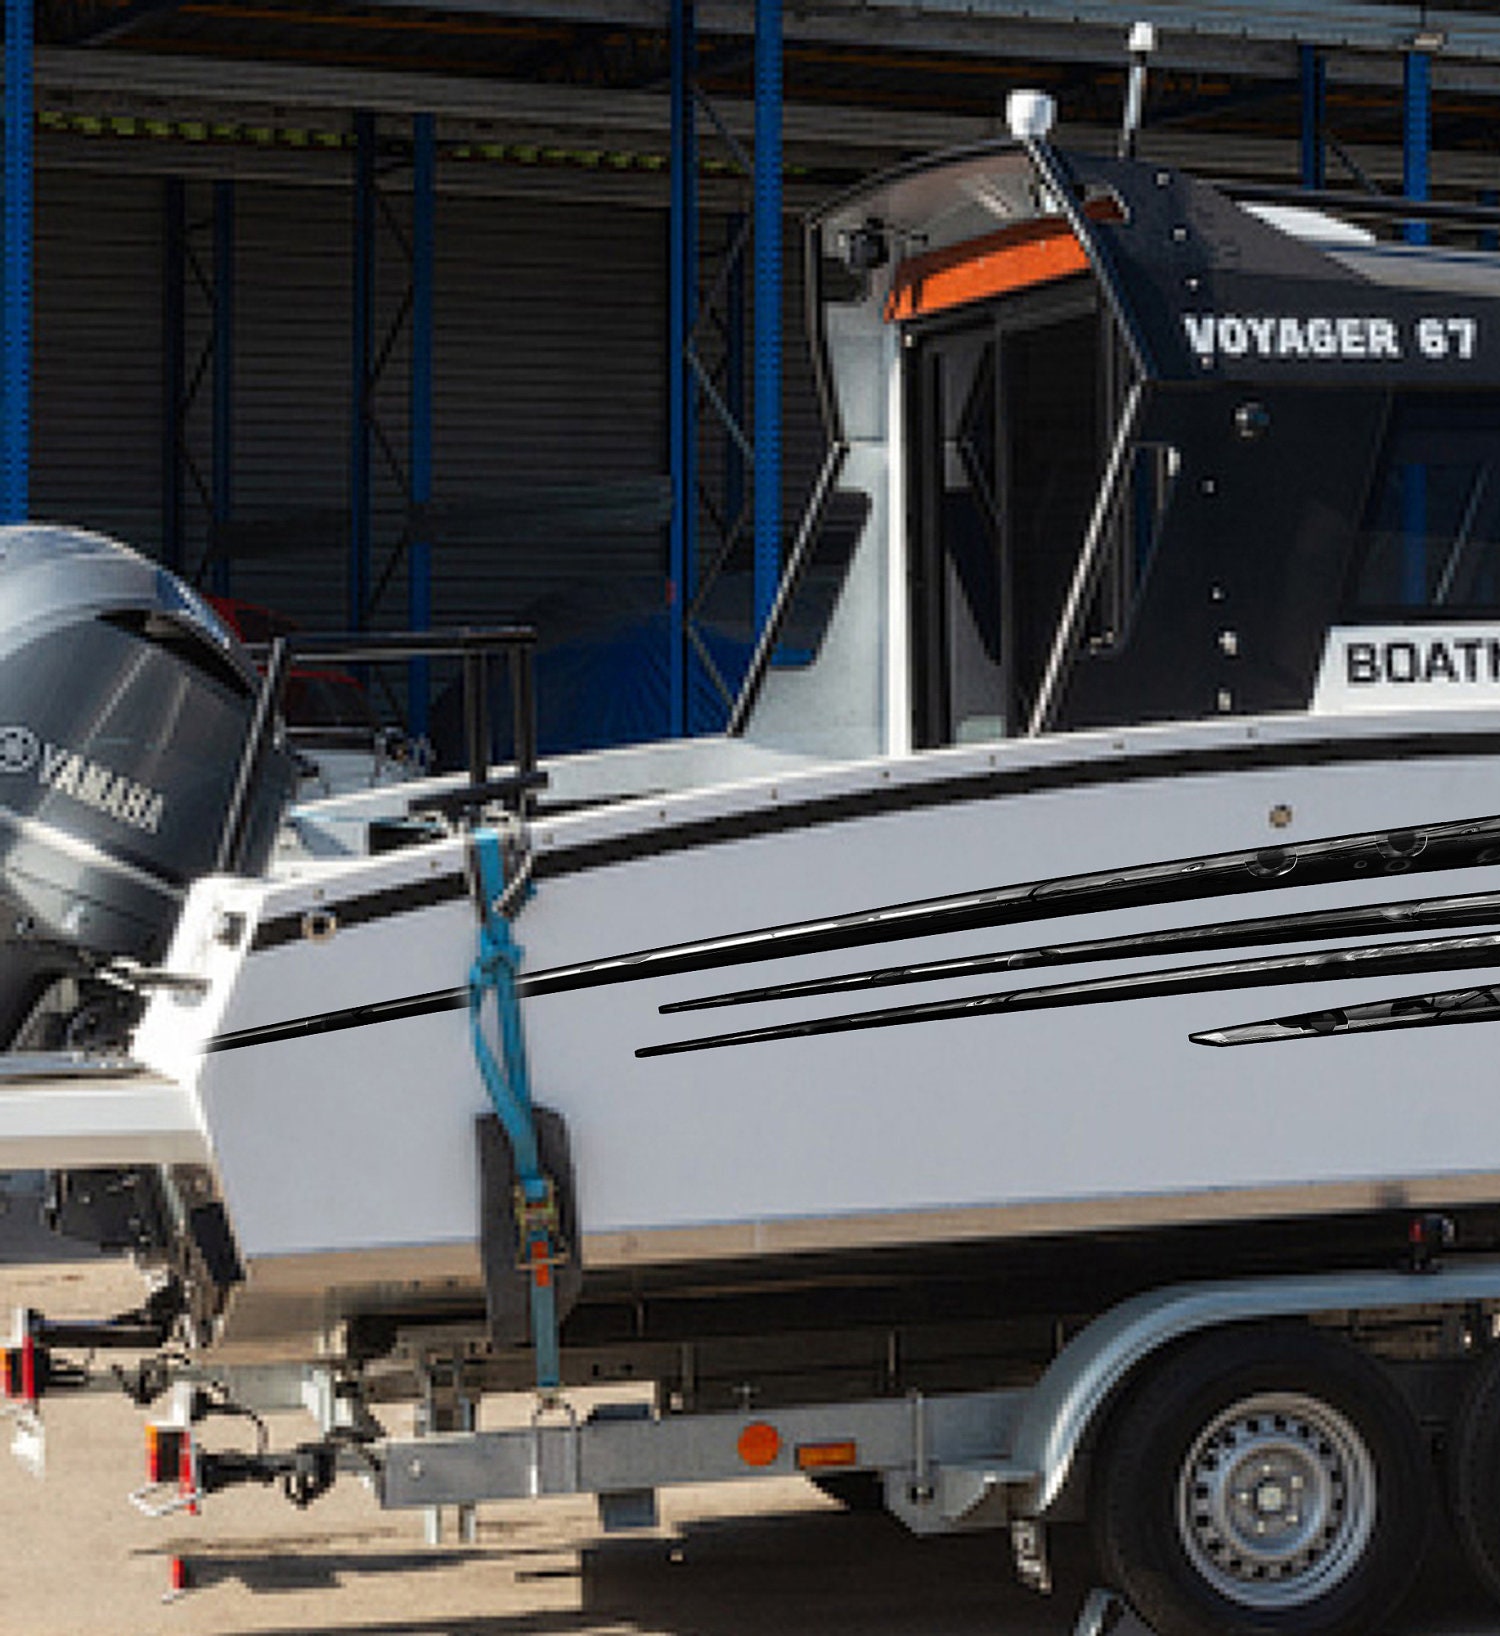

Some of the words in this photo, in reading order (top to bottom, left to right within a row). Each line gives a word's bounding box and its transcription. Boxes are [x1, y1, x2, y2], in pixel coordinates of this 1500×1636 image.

[1183, 317, 1399, 357] VOYAGER
[1418, 318, 1475, 359] 67
[39, 743, 163, 834] YAMAHA
